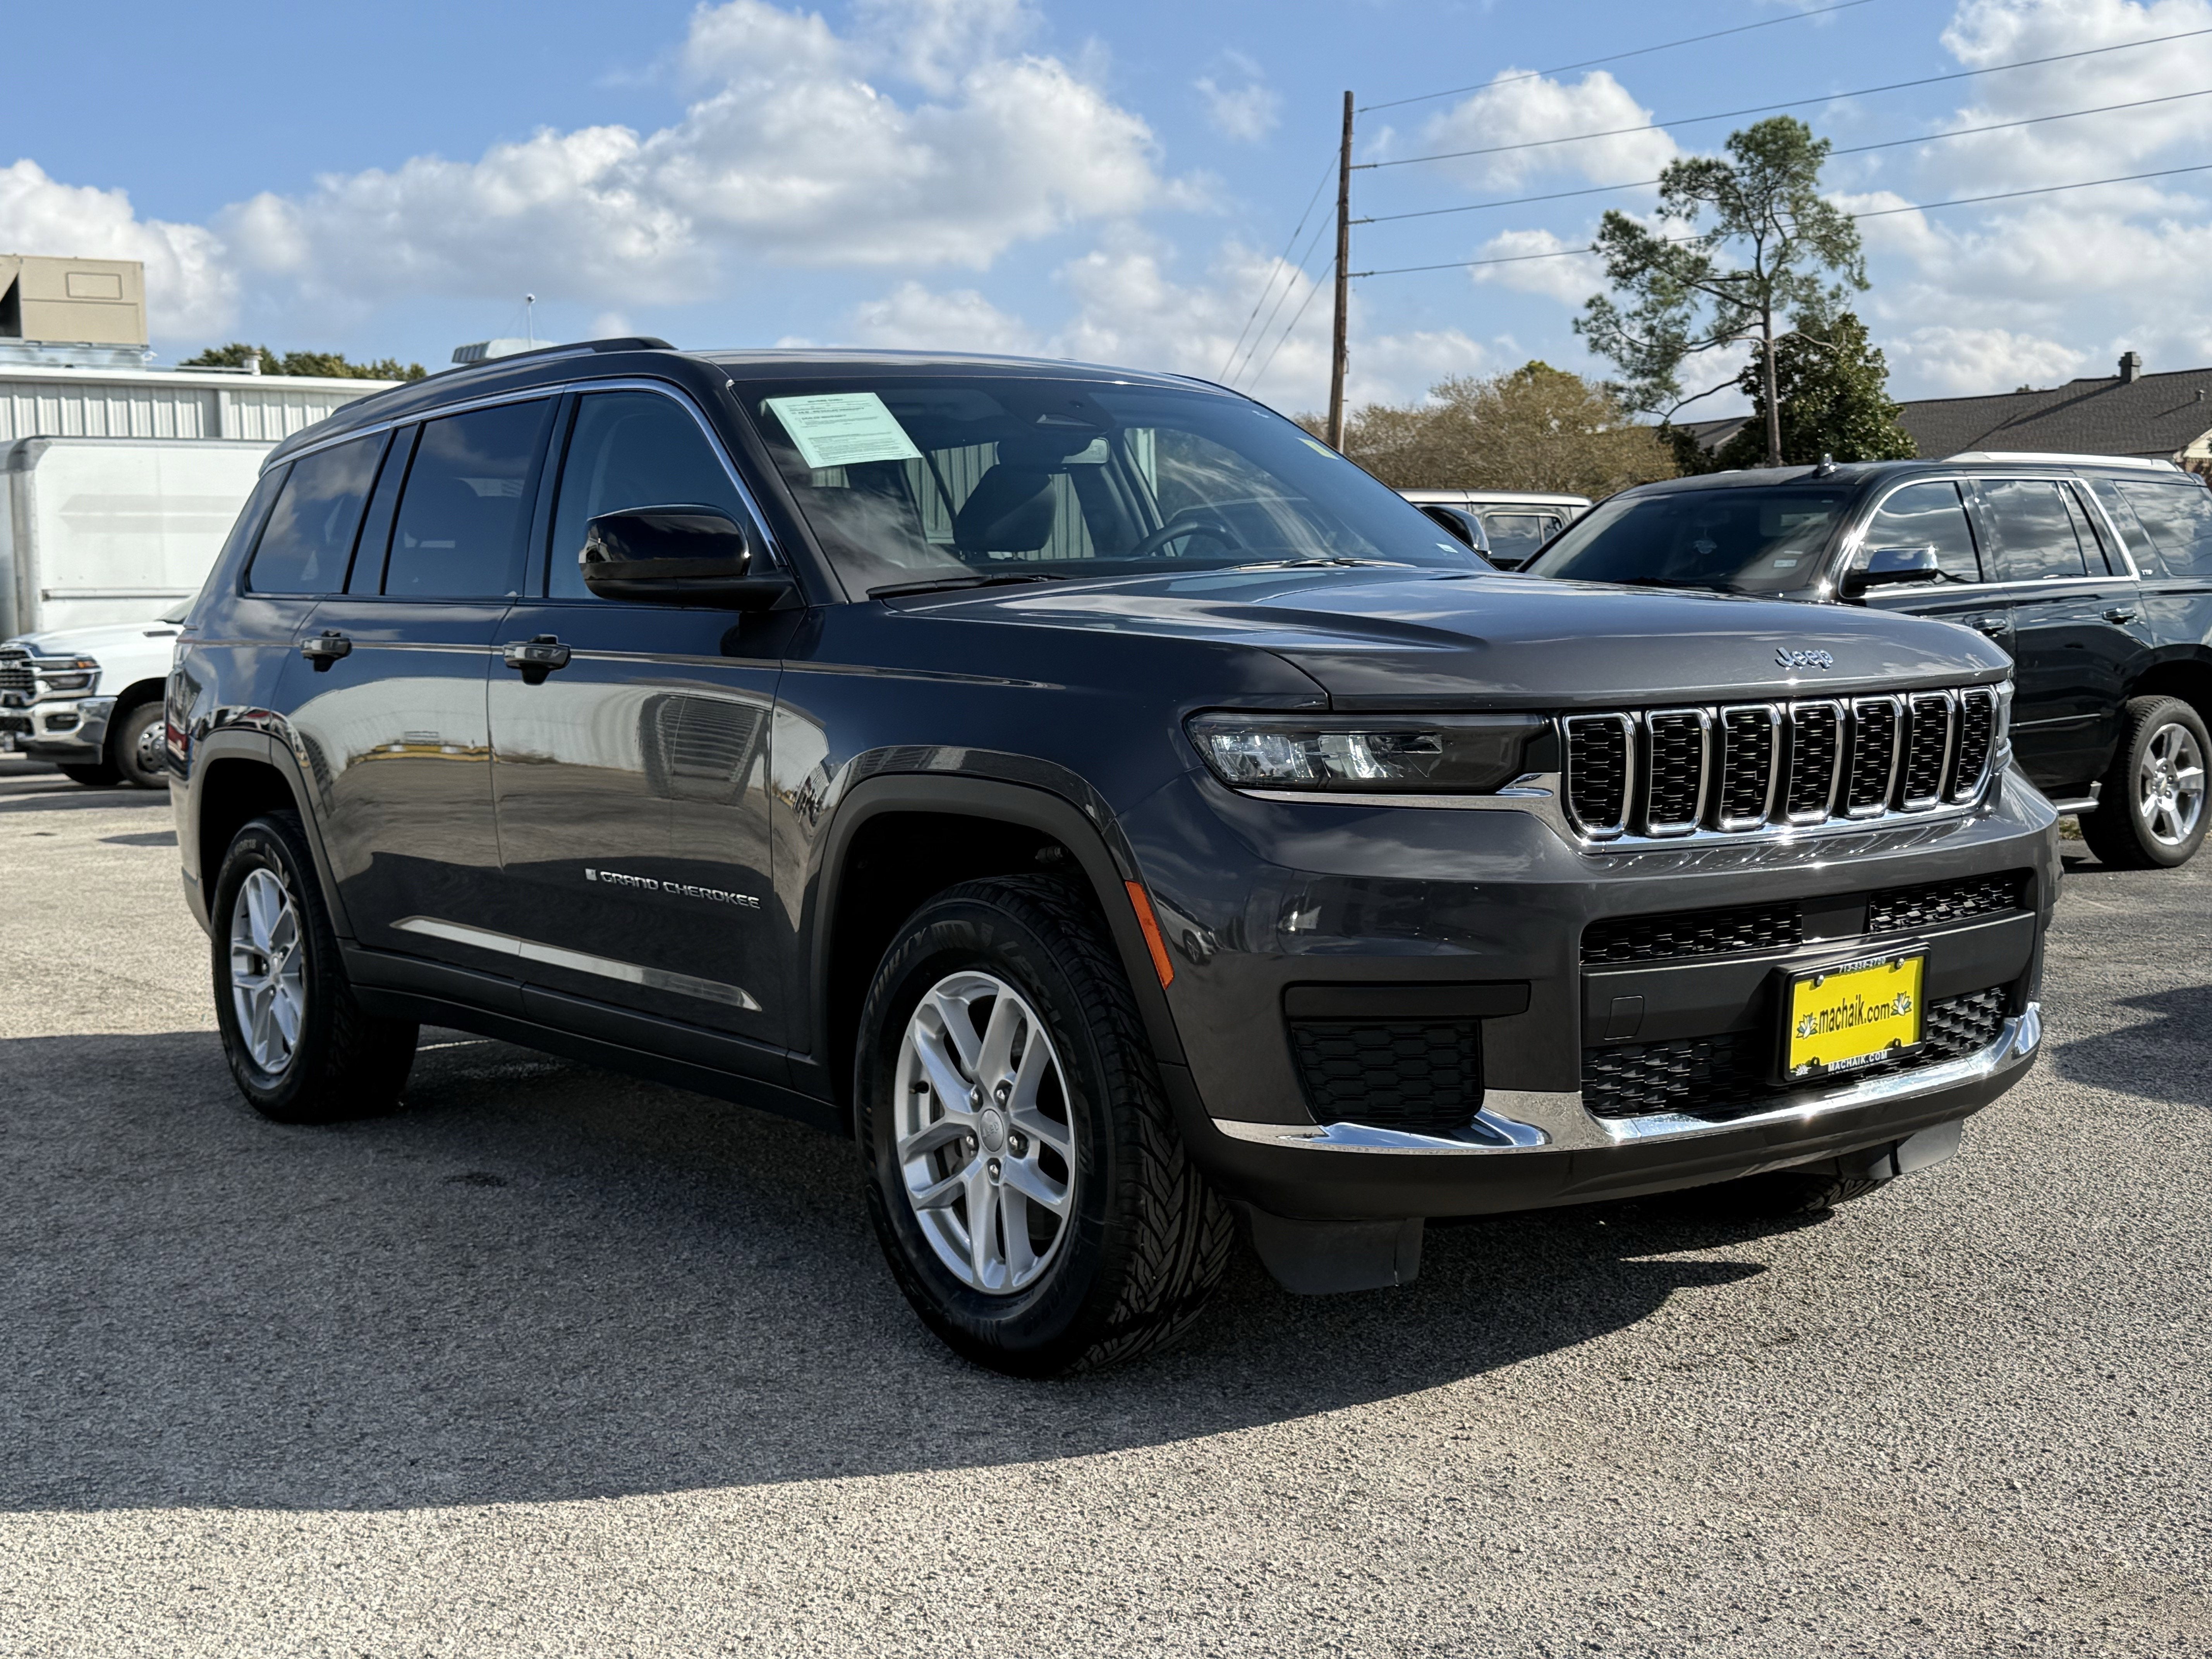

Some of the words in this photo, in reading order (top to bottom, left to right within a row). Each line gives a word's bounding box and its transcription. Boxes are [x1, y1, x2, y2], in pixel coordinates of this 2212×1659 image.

[1775, 647, 1834, 670] Jeep
[600, 871, 659, 890] GRAND
[663, 881, 761, 909] CHEROKEE
[1818, 994, 1890, 1034] machaik.com
[1827, 1051, 1888, 1072] MACHAIK.COM
